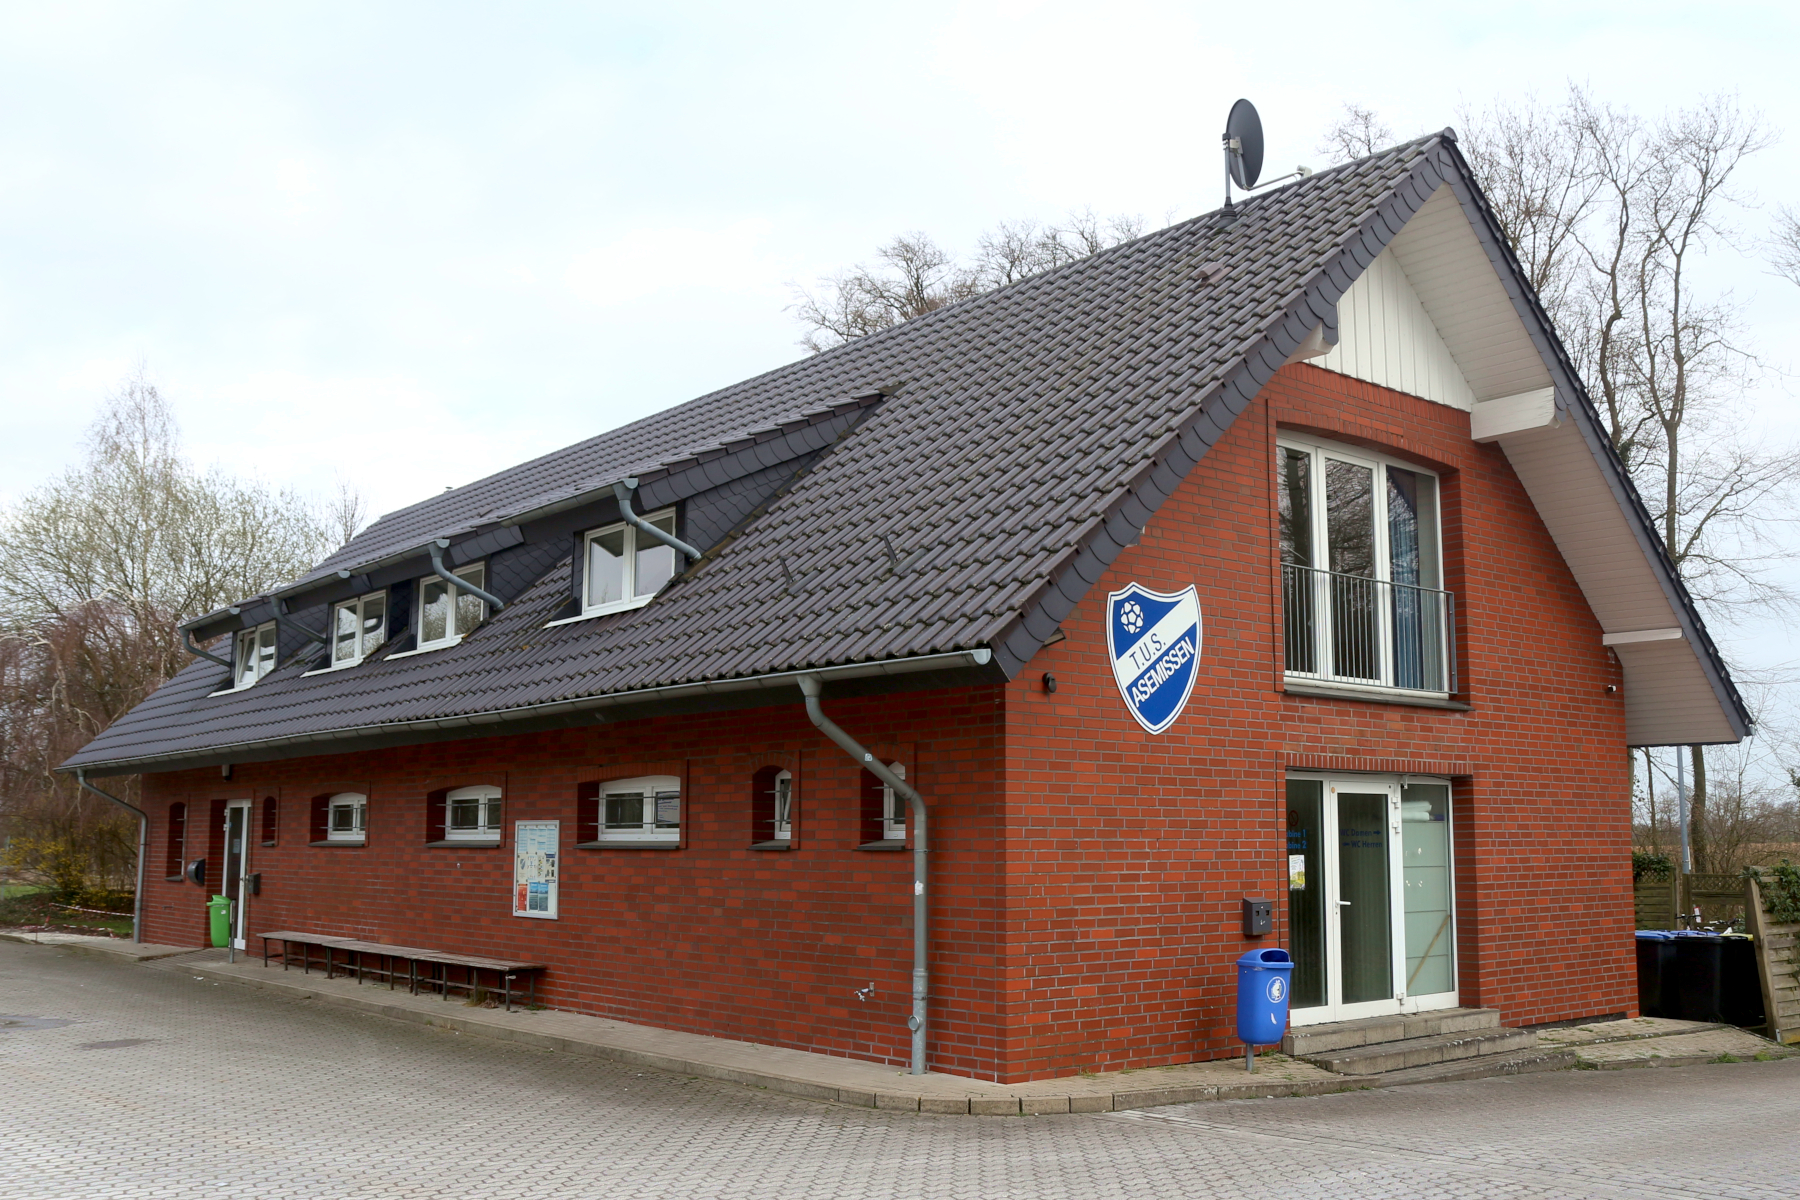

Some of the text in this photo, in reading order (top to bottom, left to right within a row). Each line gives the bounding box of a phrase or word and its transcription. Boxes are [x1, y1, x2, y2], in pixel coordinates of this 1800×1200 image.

[1129, 632, 1166, 670] T.U.S.
[1131, 636, 1195, 708] ASEMISSEN
[1302, 829, 1307, 837] 1
[1302, 840, 1307, 849] 2
